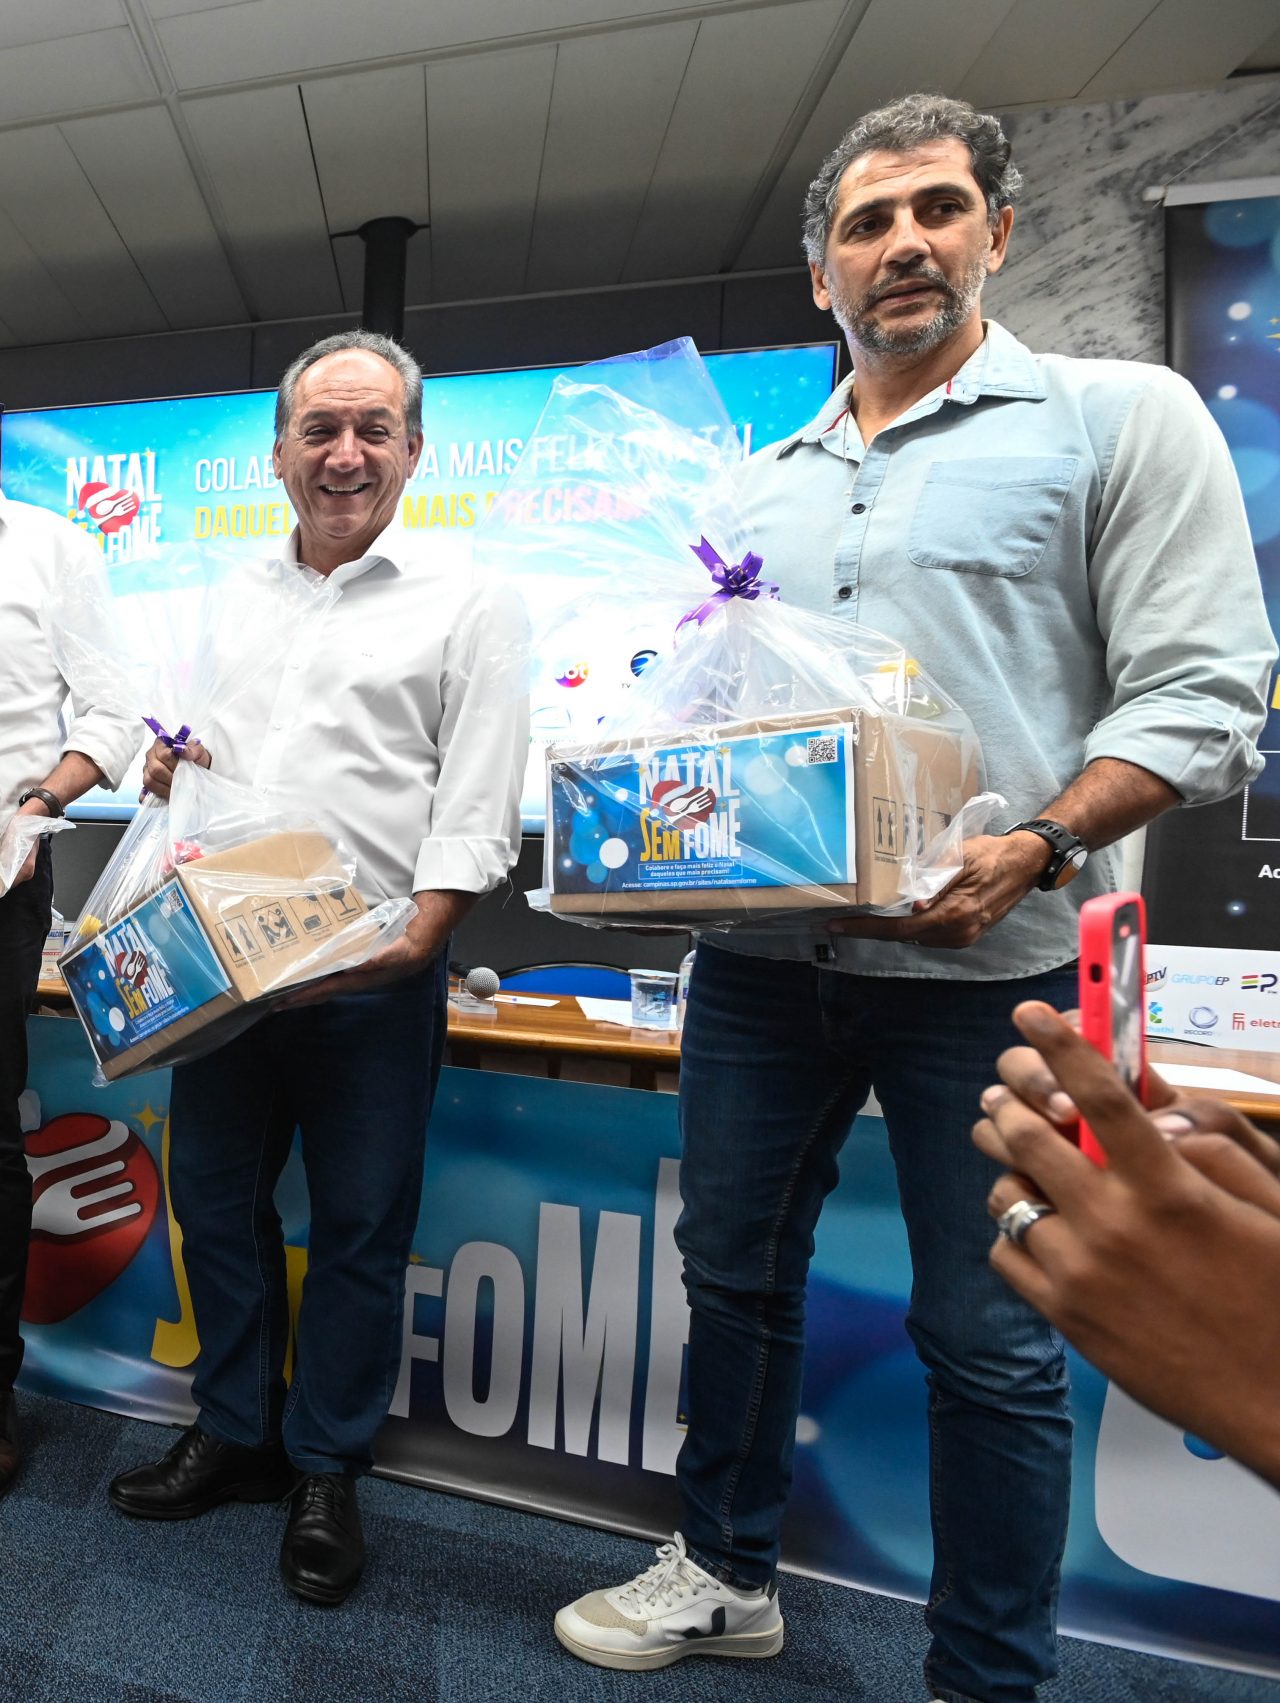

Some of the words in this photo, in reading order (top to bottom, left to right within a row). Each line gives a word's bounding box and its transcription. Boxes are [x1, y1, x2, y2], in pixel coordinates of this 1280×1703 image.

[65, 451, 162, 507] NATAL
[194, 454, 282, 493] COLAB
[448, 438, 523, 480] MAIS
[194, 501, 291, 540] DAQUEL
[402, 492, 476, 529] MAIS
[639, 748, 740, 805] NATAL
[640, 807, 681, 862] SEM
[683, 798, 742, 860] FOME
[102, 917, 155, 978] NATAL
[1144, 966, 1167, 985] PTV
[115, 977, 149, 1020] SEM
[140, 953, 175, 1008] FOME
